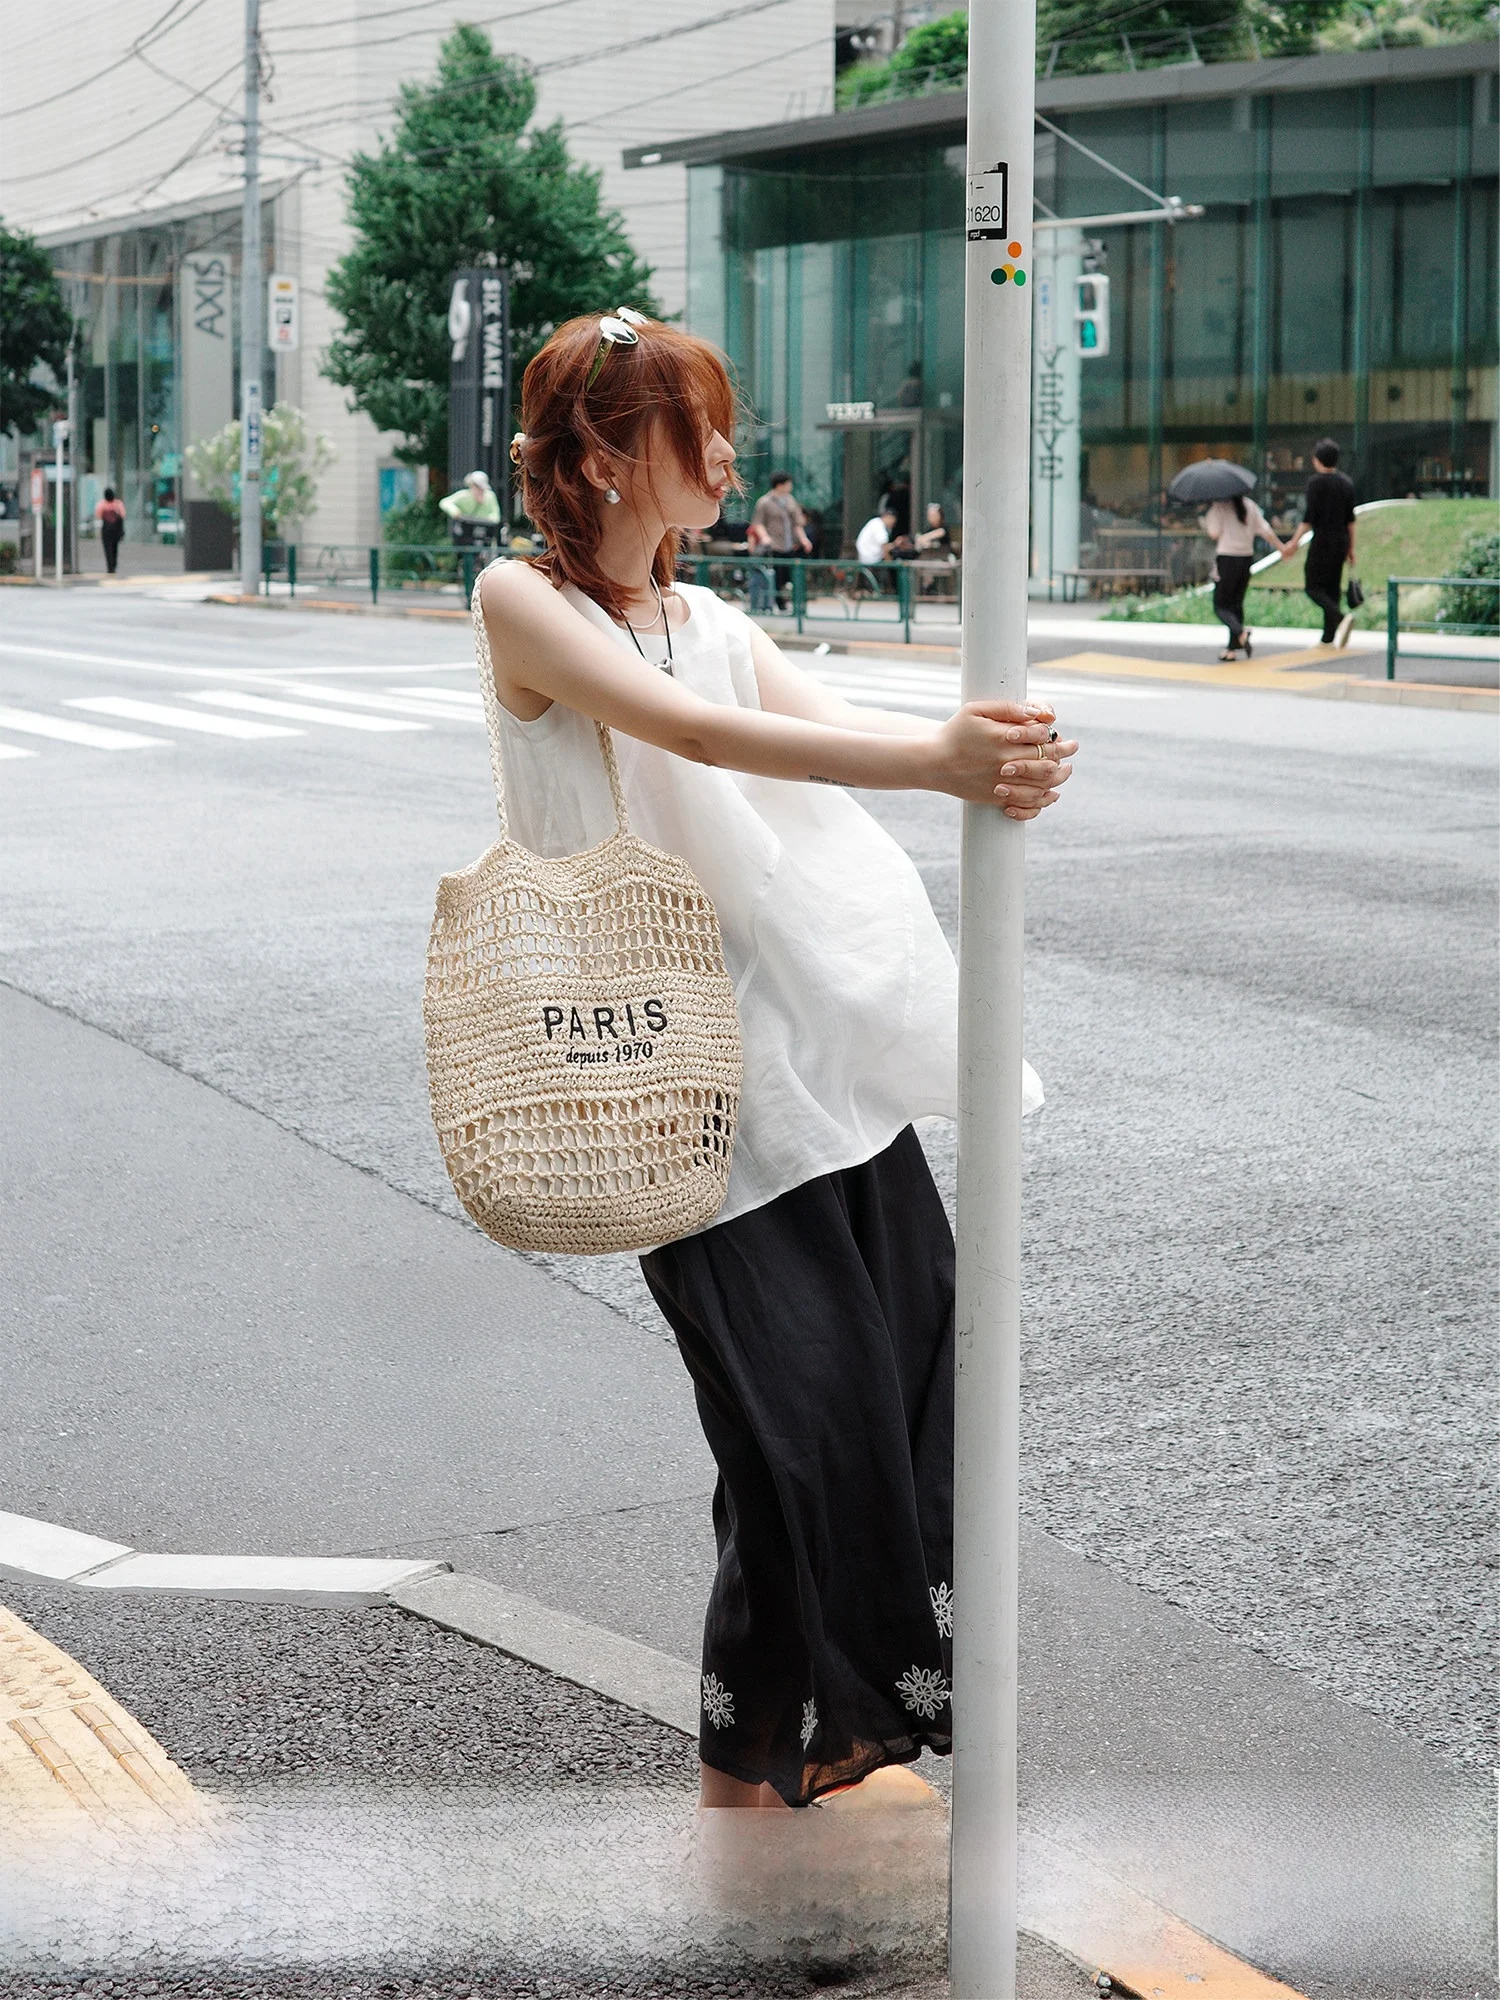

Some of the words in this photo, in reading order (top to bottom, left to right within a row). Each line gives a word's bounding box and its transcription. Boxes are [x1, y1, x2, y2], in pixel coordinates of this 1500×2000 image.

[967, 206, 1001, 222] 1620
[194, 259, 225, 339] AXIS
[482, 278, 502, 317] SIX
[483, 321, 503, 389] WAKE
[1037, 345, 1074, 480] VERVE
[542, 999, 668, 1041] PARIS
[565, 1045, 609, 1070] depuis
[614, 1041, 653, 1062] 1970
